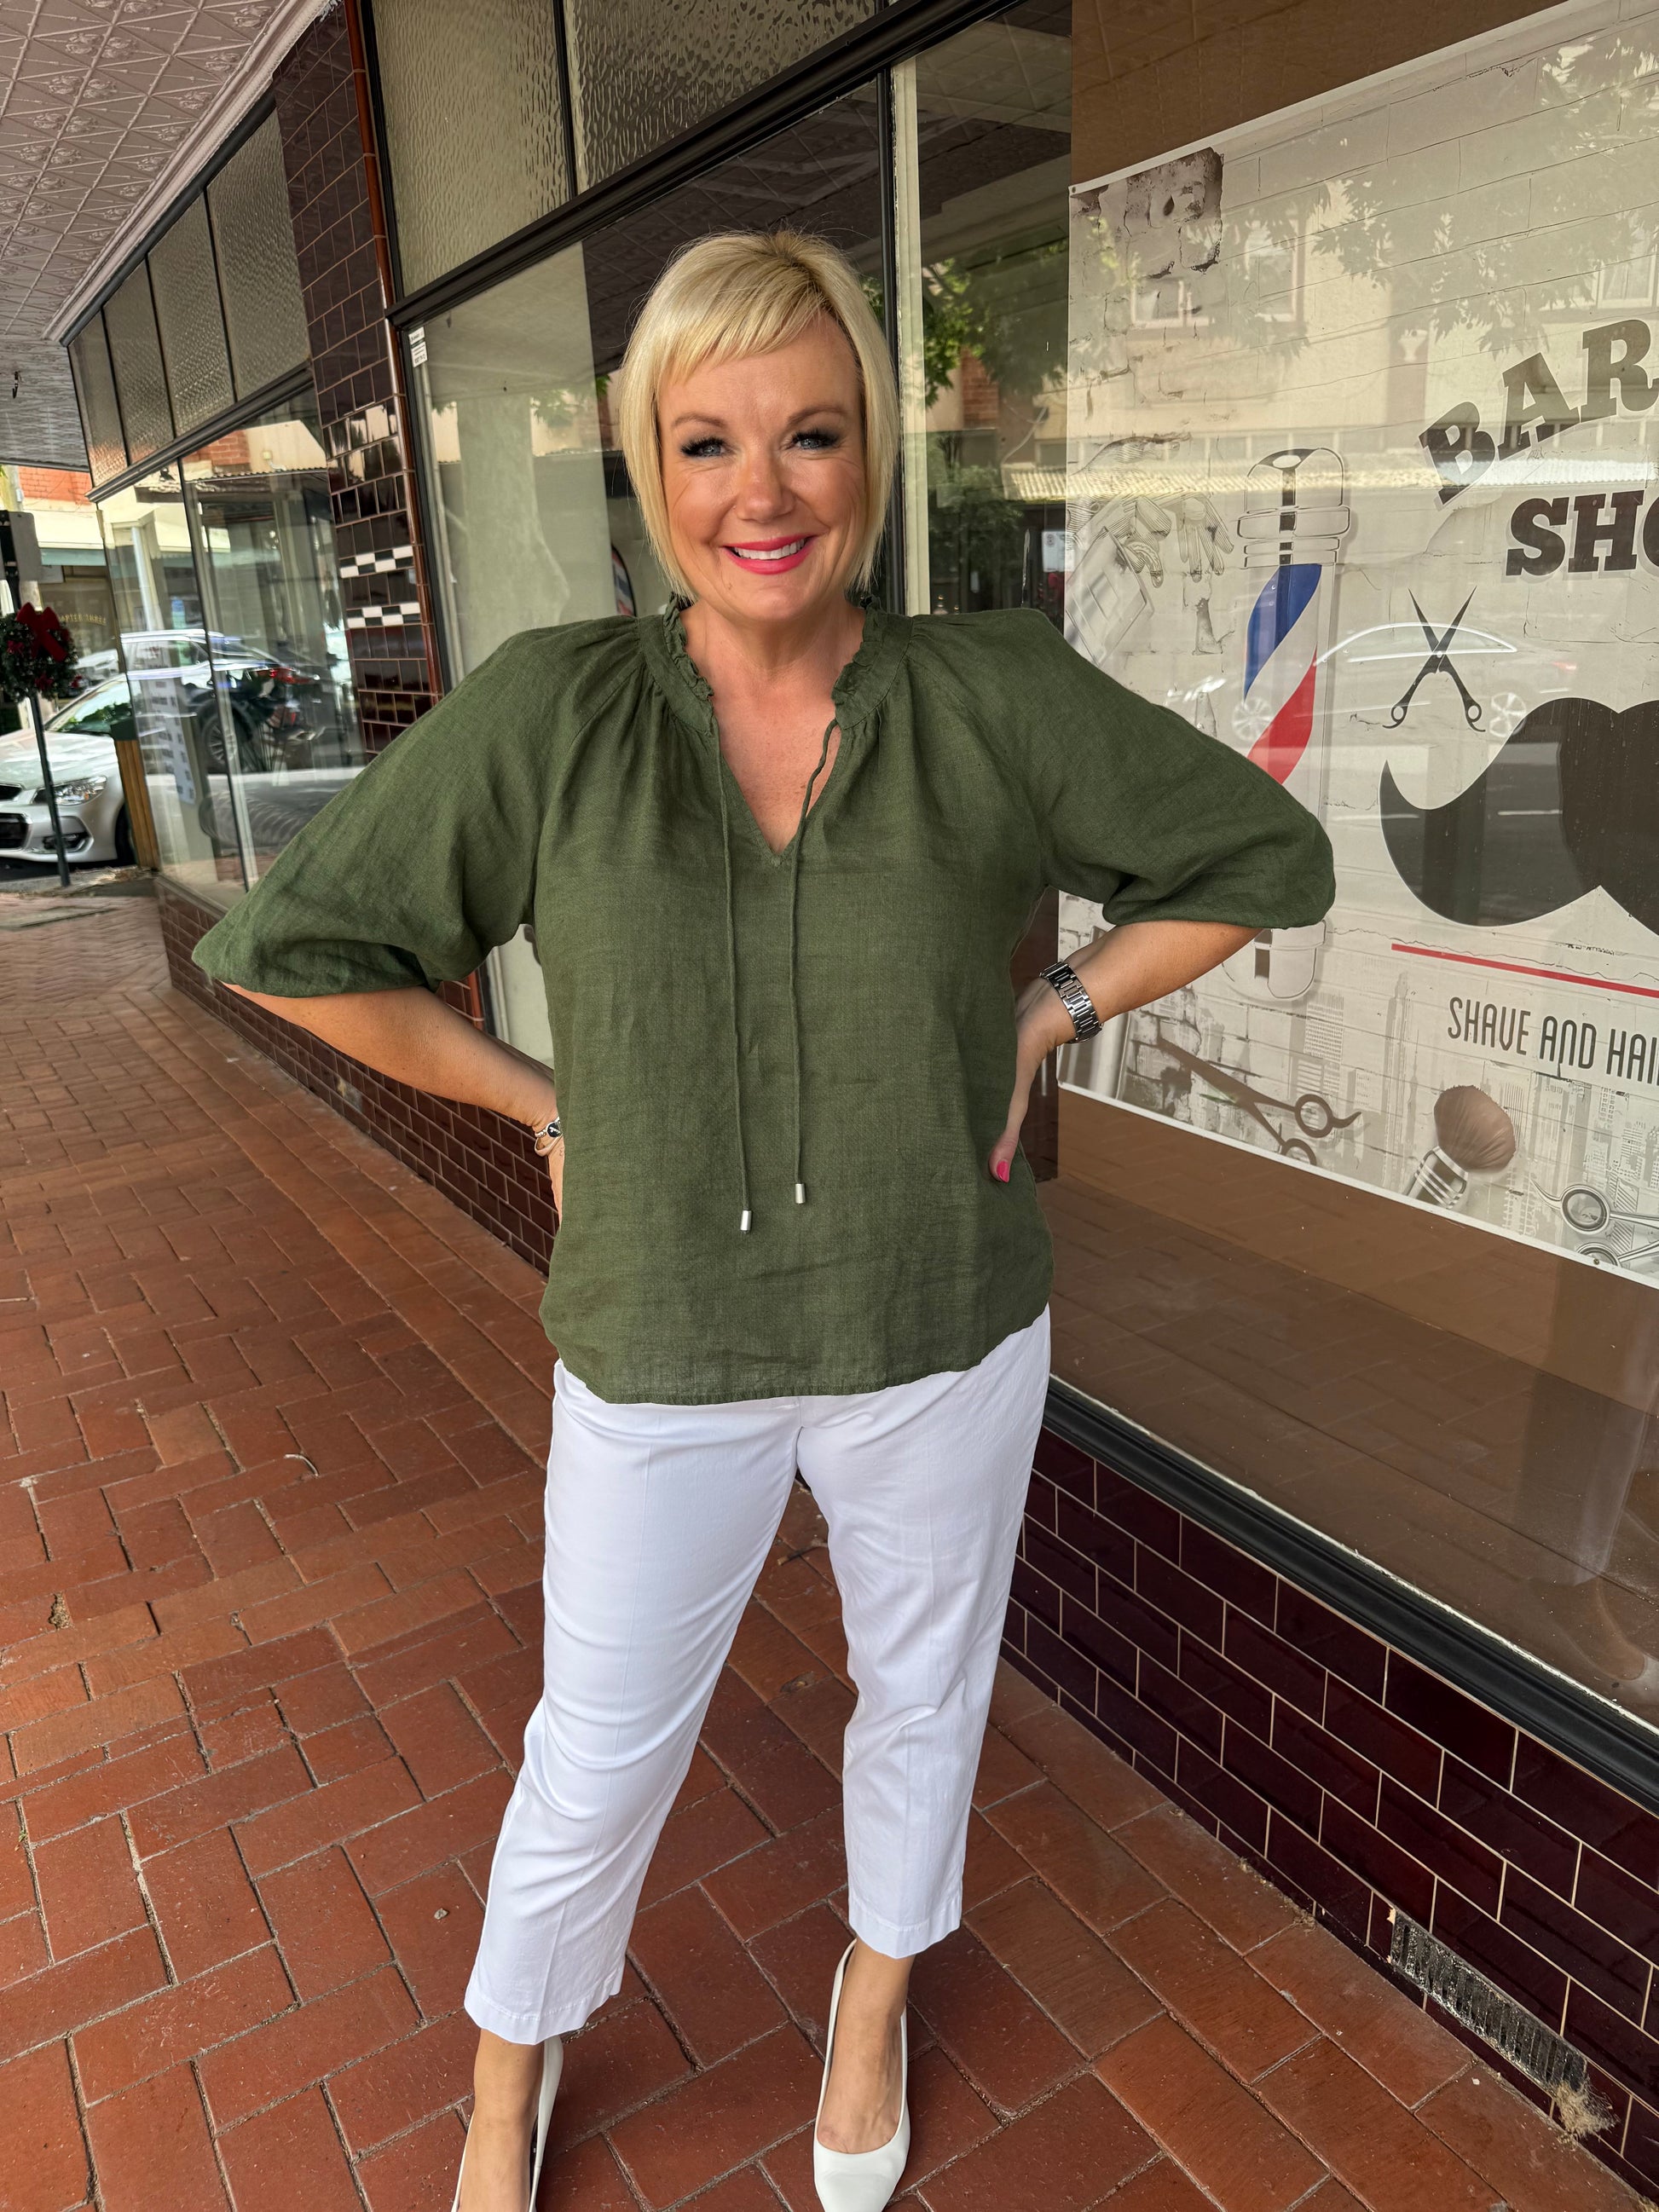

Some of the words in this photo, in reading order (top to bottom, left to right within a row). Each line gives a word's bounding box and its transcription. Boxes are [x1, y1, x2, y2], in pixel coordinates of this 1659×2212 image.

[1448, 996, 1531, 1055] SHAVE
[1540, 1015, 1597, 1069] AND
[1606, 1029, 1659, 1086] HAI
